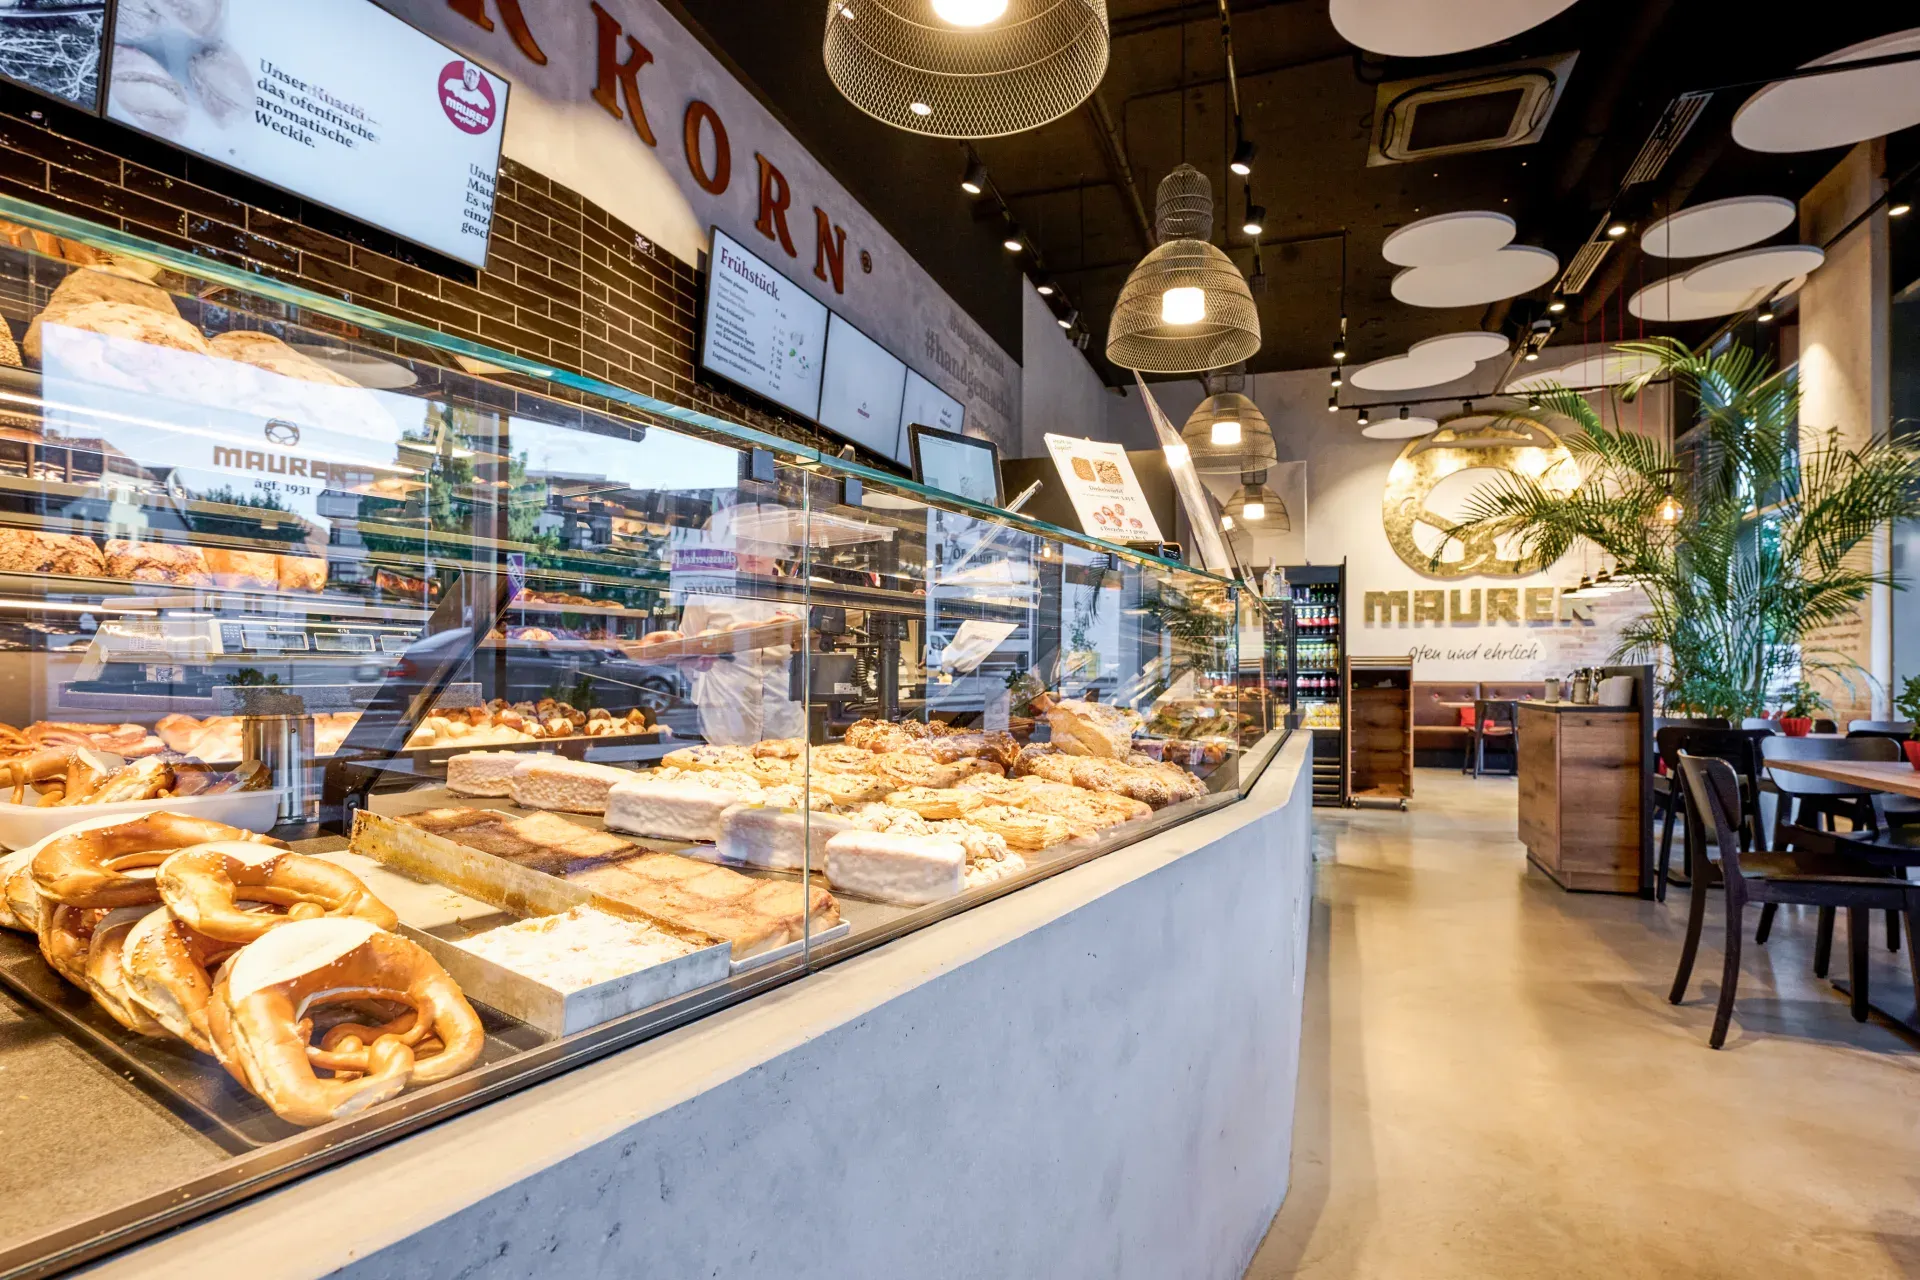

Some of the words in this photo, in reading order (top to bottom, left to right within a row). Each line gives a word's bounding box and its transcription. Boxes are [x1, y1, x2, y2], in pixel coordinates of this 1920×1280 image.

[260, 57, 307, 92] Unser
[256, 96, 353, 148] aromatische
[257, 78, 286, 99] das
[290, 94, 375, 141] ofenfrische
[446, 96, 489, 127] MAURER
[255, 110, 316, 148] Weckle.
[465, 191, 479, 207] Es
[720, 246, 780, 302] Frühstück.
[285, 483, 311, 495] 1931
[1364, 586, 1595, 627] MAURER
[1447, 642, 1482, 660] und
[1483, 642, 1538, 661] ehrlich
